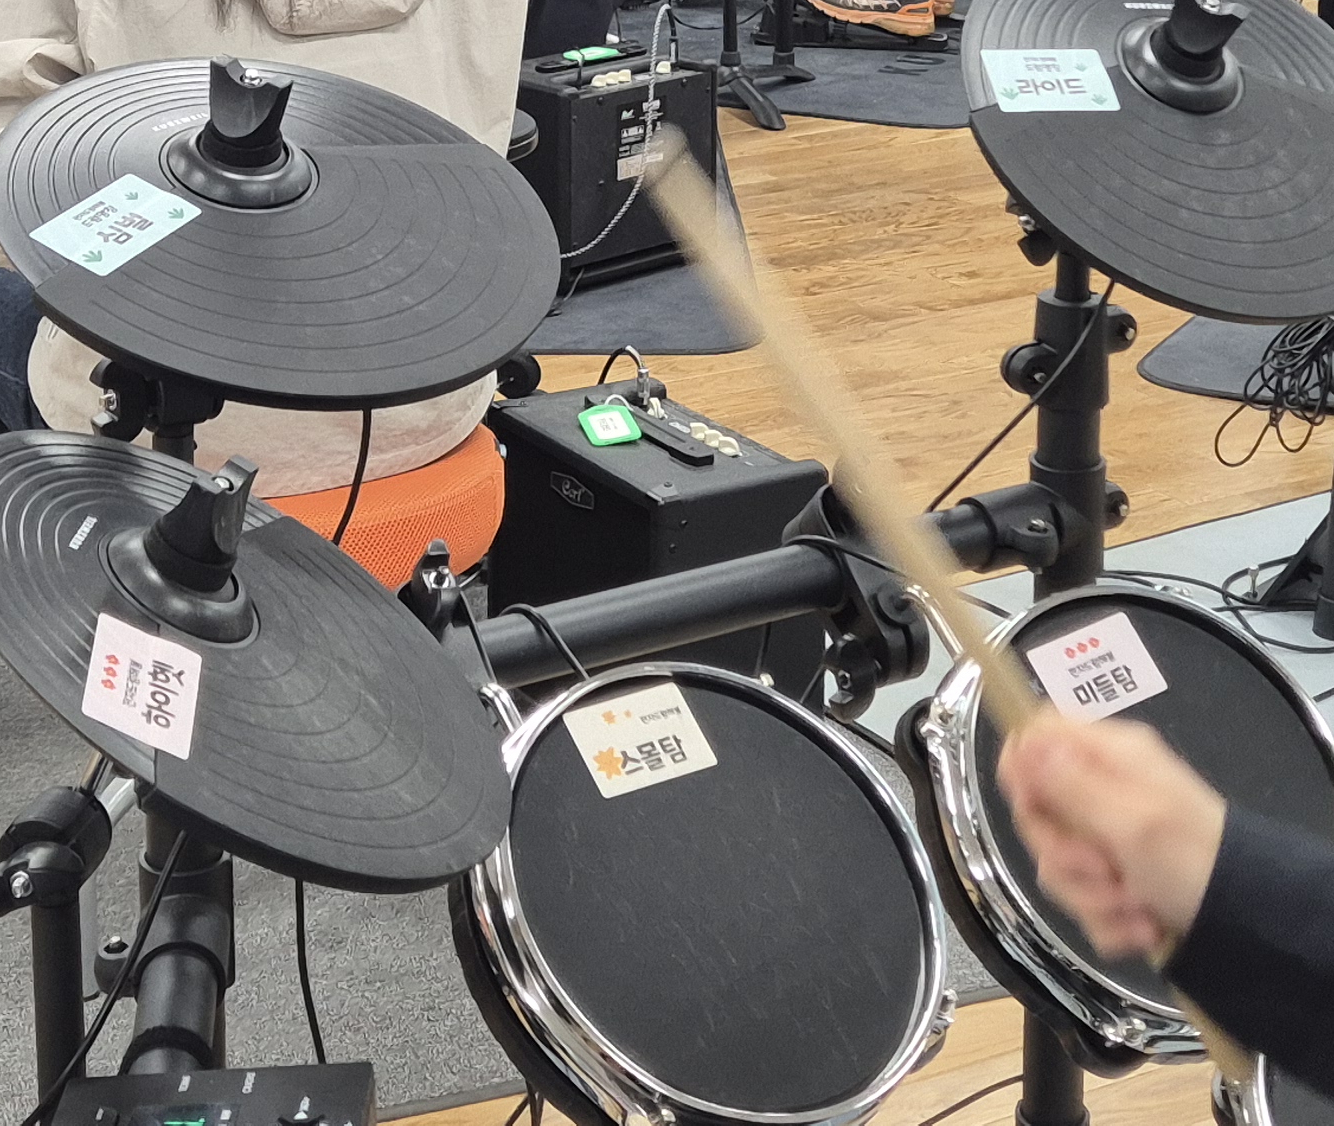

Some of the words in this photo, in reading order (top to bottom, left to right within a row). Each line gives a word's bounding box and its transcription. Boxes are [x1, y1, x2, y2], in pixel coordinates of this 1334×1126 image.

[1015, 78, 1088, 96] 라이드
[97, 213, 154, 245] 심벌
[141, 659, 185, 729] 하이헷
[1072, 664, 1138, 706] 미들탐
[620, 734, 688, 776] 스몰탐
